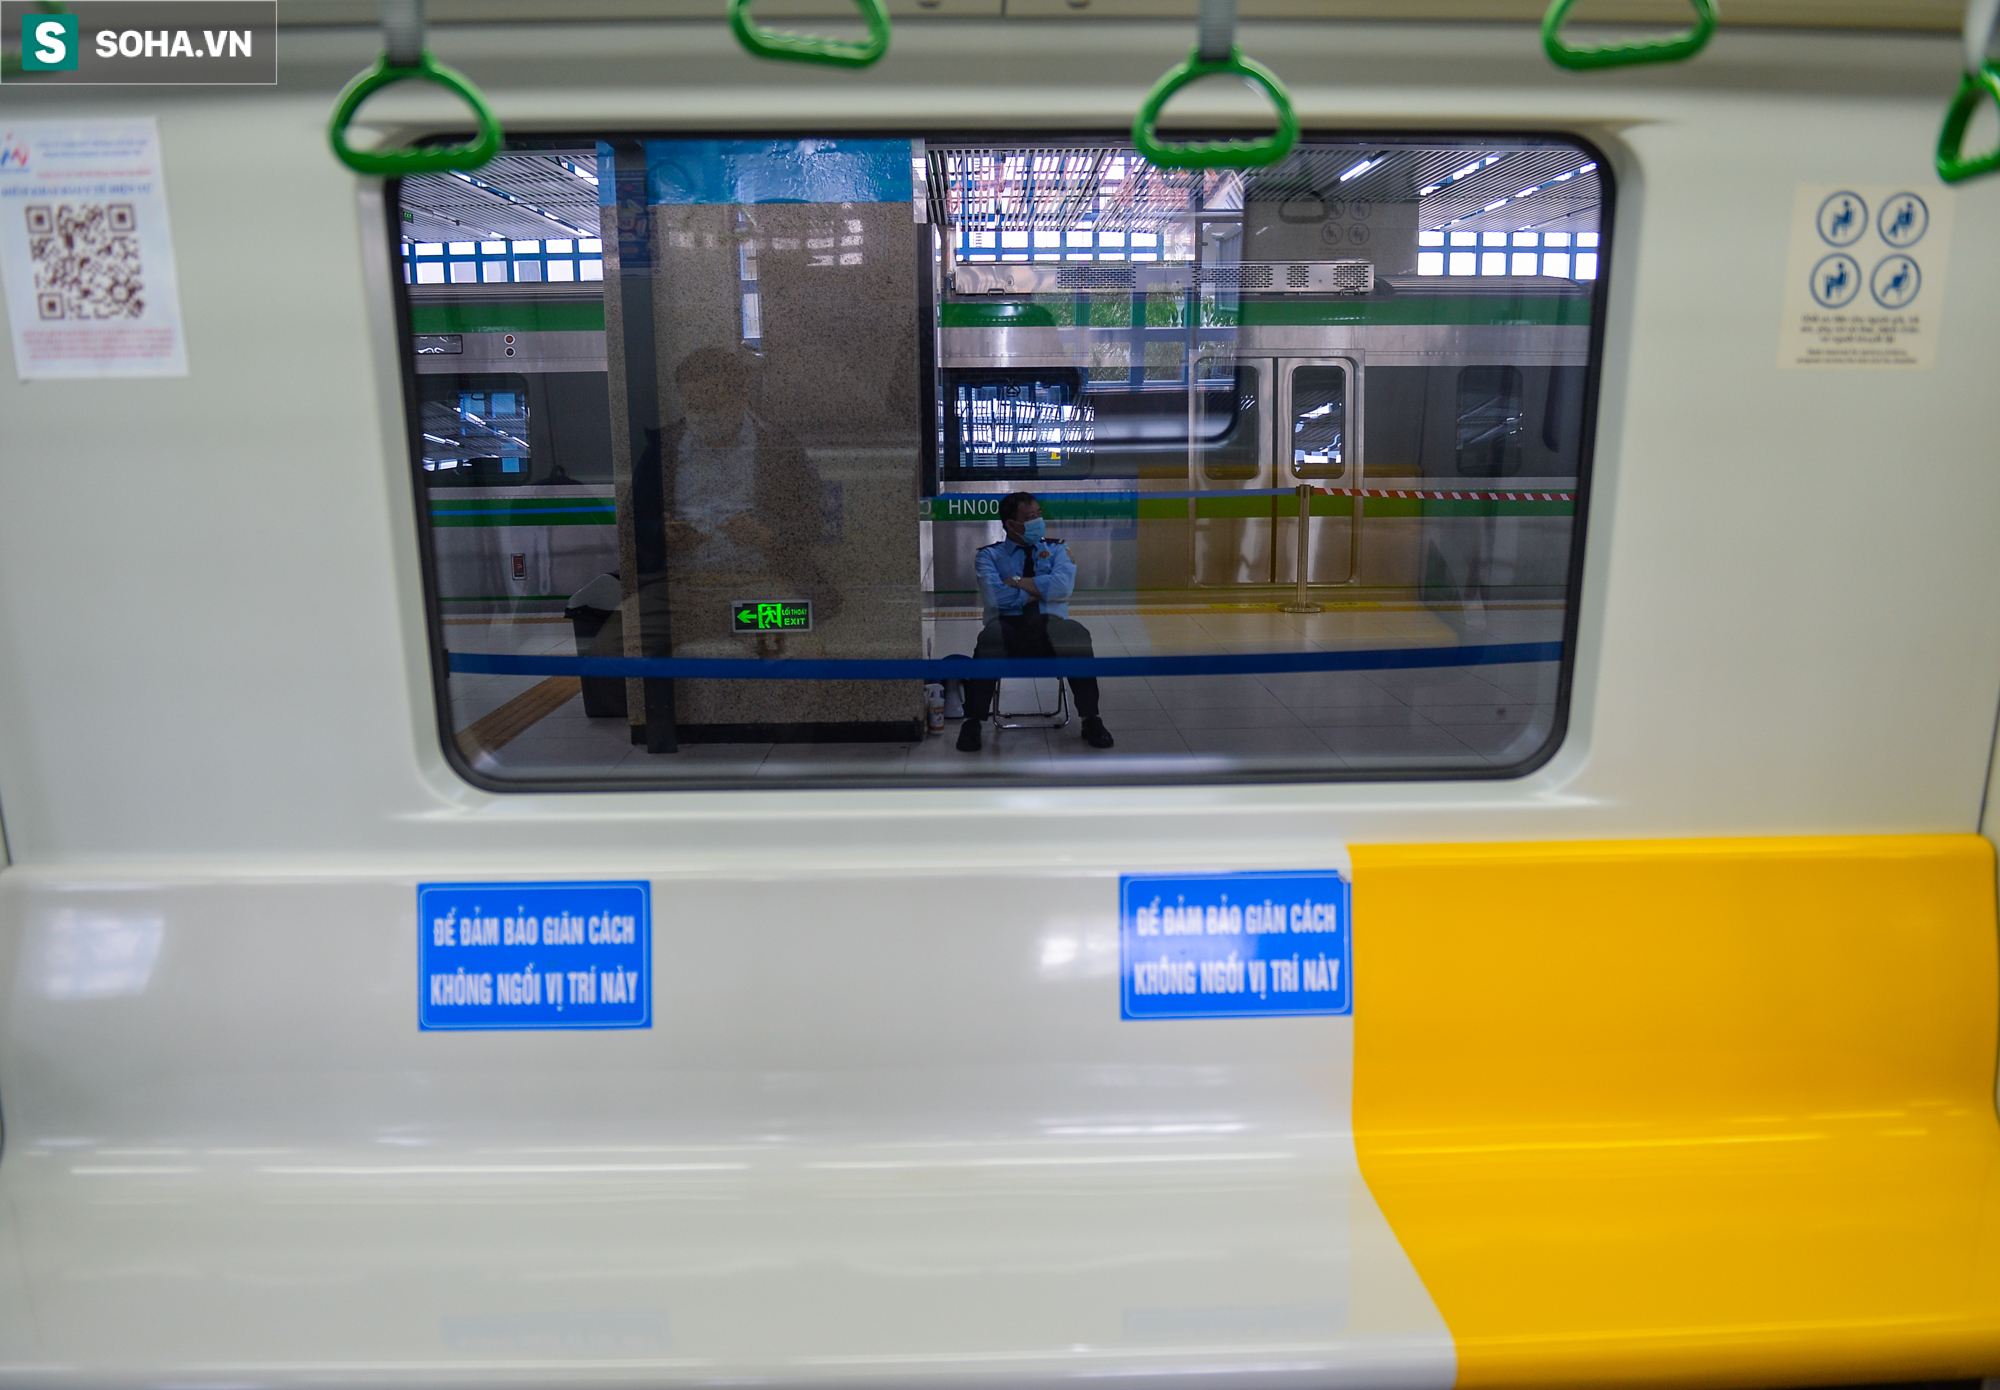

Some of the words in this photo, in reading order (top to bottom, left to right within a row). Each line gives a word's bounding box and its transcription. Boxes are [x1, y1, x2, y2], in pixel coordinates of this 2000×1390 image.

[433, 906, 457, 946] ĐỂ
[460, 906, 500, 946] ĐẢM
[503, 905, 539, 946] BẢO
[542, 910, 584, 946] GIÃN
[588, 910, 635, 945] CÁCH
[1136, 895, 1160, 936] ĐỂ
[1163, 895, 1203, 935] ĐẢM
[1206, 894, 1242, 935] BẢO
[1245, 899, 1287, 934] GIÃN
[1290, 899, 1336, 933] CÁCH
[430, 967, 493, 1005] KHÔNG
[545, 972, 564, 1011] VỊ
[567, 966, 597, 1004] TRÍ
[601, 965, 638, 1004] NÀY
[1134, 955, 1197, 995] KHÔNG
[1248, 960, 1266, 1000] VỊ
[1270, 952, 1299, 992] TRÍ
[1303, 952, 1339, 992] NÀY
